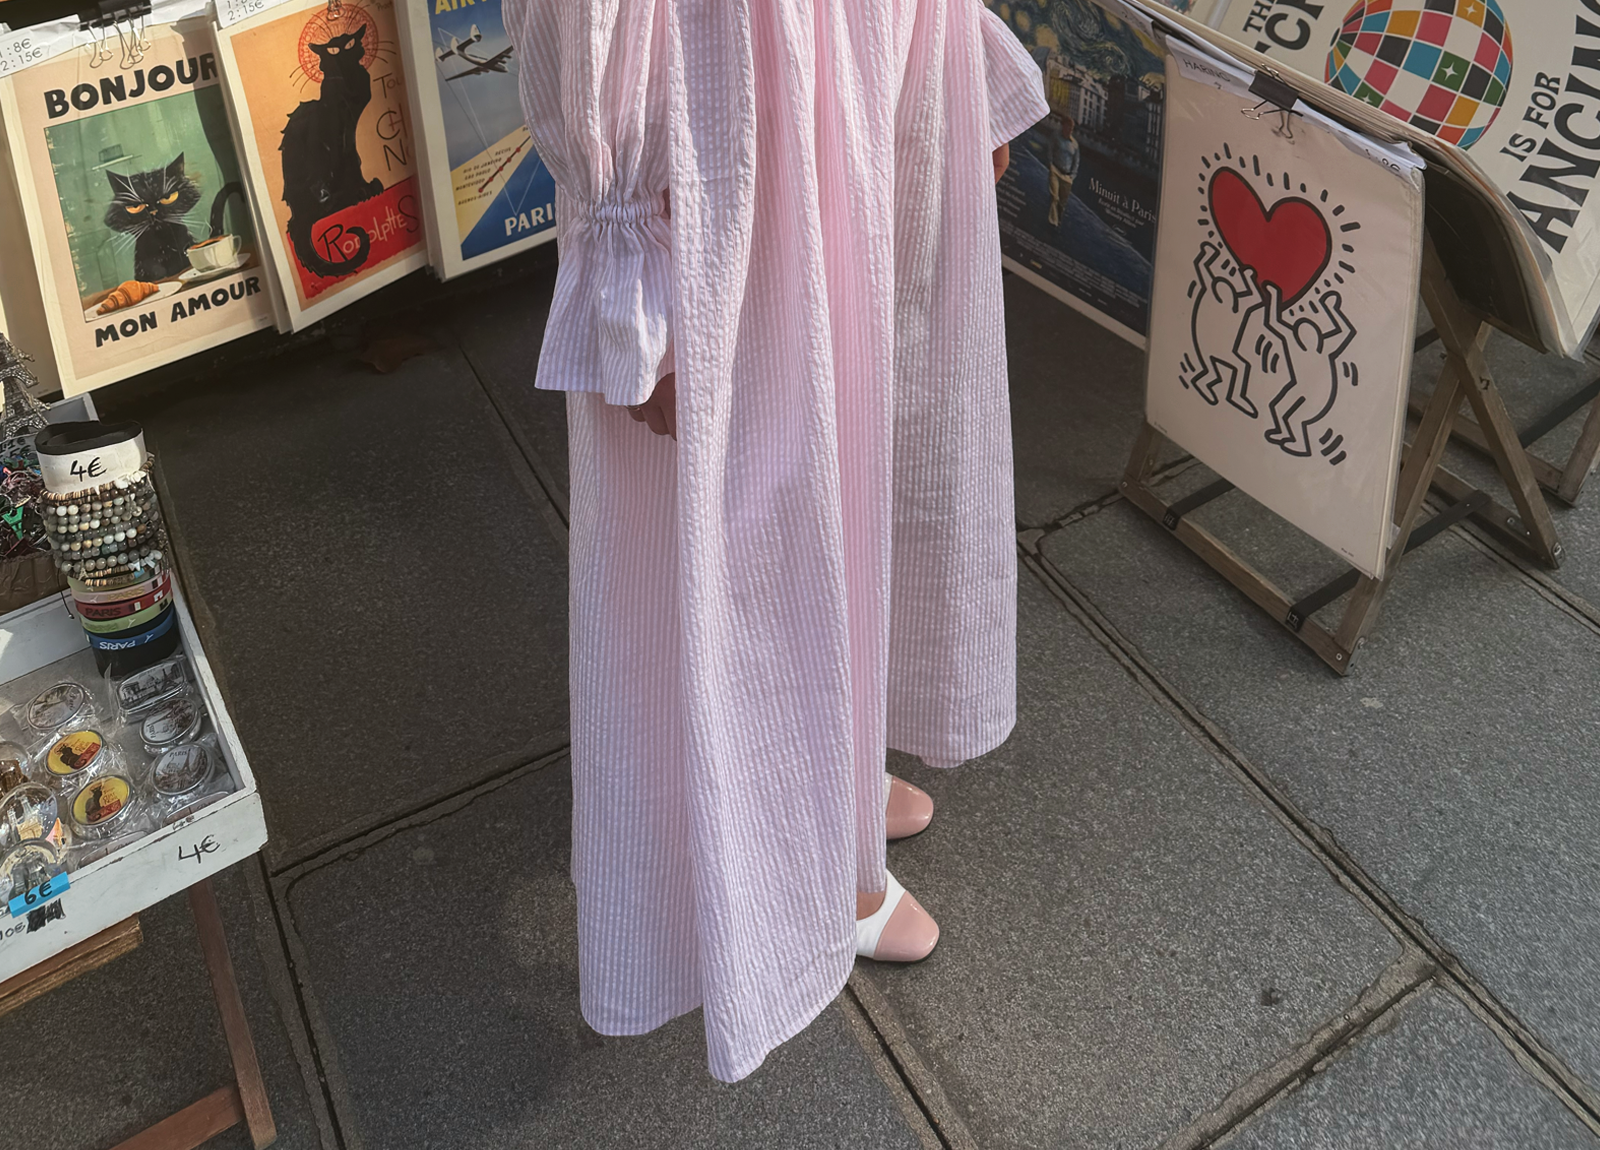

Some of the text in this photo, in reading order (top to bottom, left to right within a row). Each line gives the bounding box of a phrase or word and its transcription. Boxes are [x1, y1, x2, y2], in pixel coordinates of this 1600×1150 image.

[0, 48, 43, 71] 2:15€
[43, 52, 218, 119] BONJOUR
[1499, 71, 1560, 162] IS FOR
[1088, 177, 1157, 223] Minuit à Paris
[504, 202, 553, 237] PARI
[95, 276, 261, 348] MON AMOUR
[70, 456, 107, 481] 4€
[85, 607, 122, 617] PARIS
[99, 640, 136, 650] PARIS
[169, 750, 188, 758] PARIS
[178, 833, 222, 864] 4€
